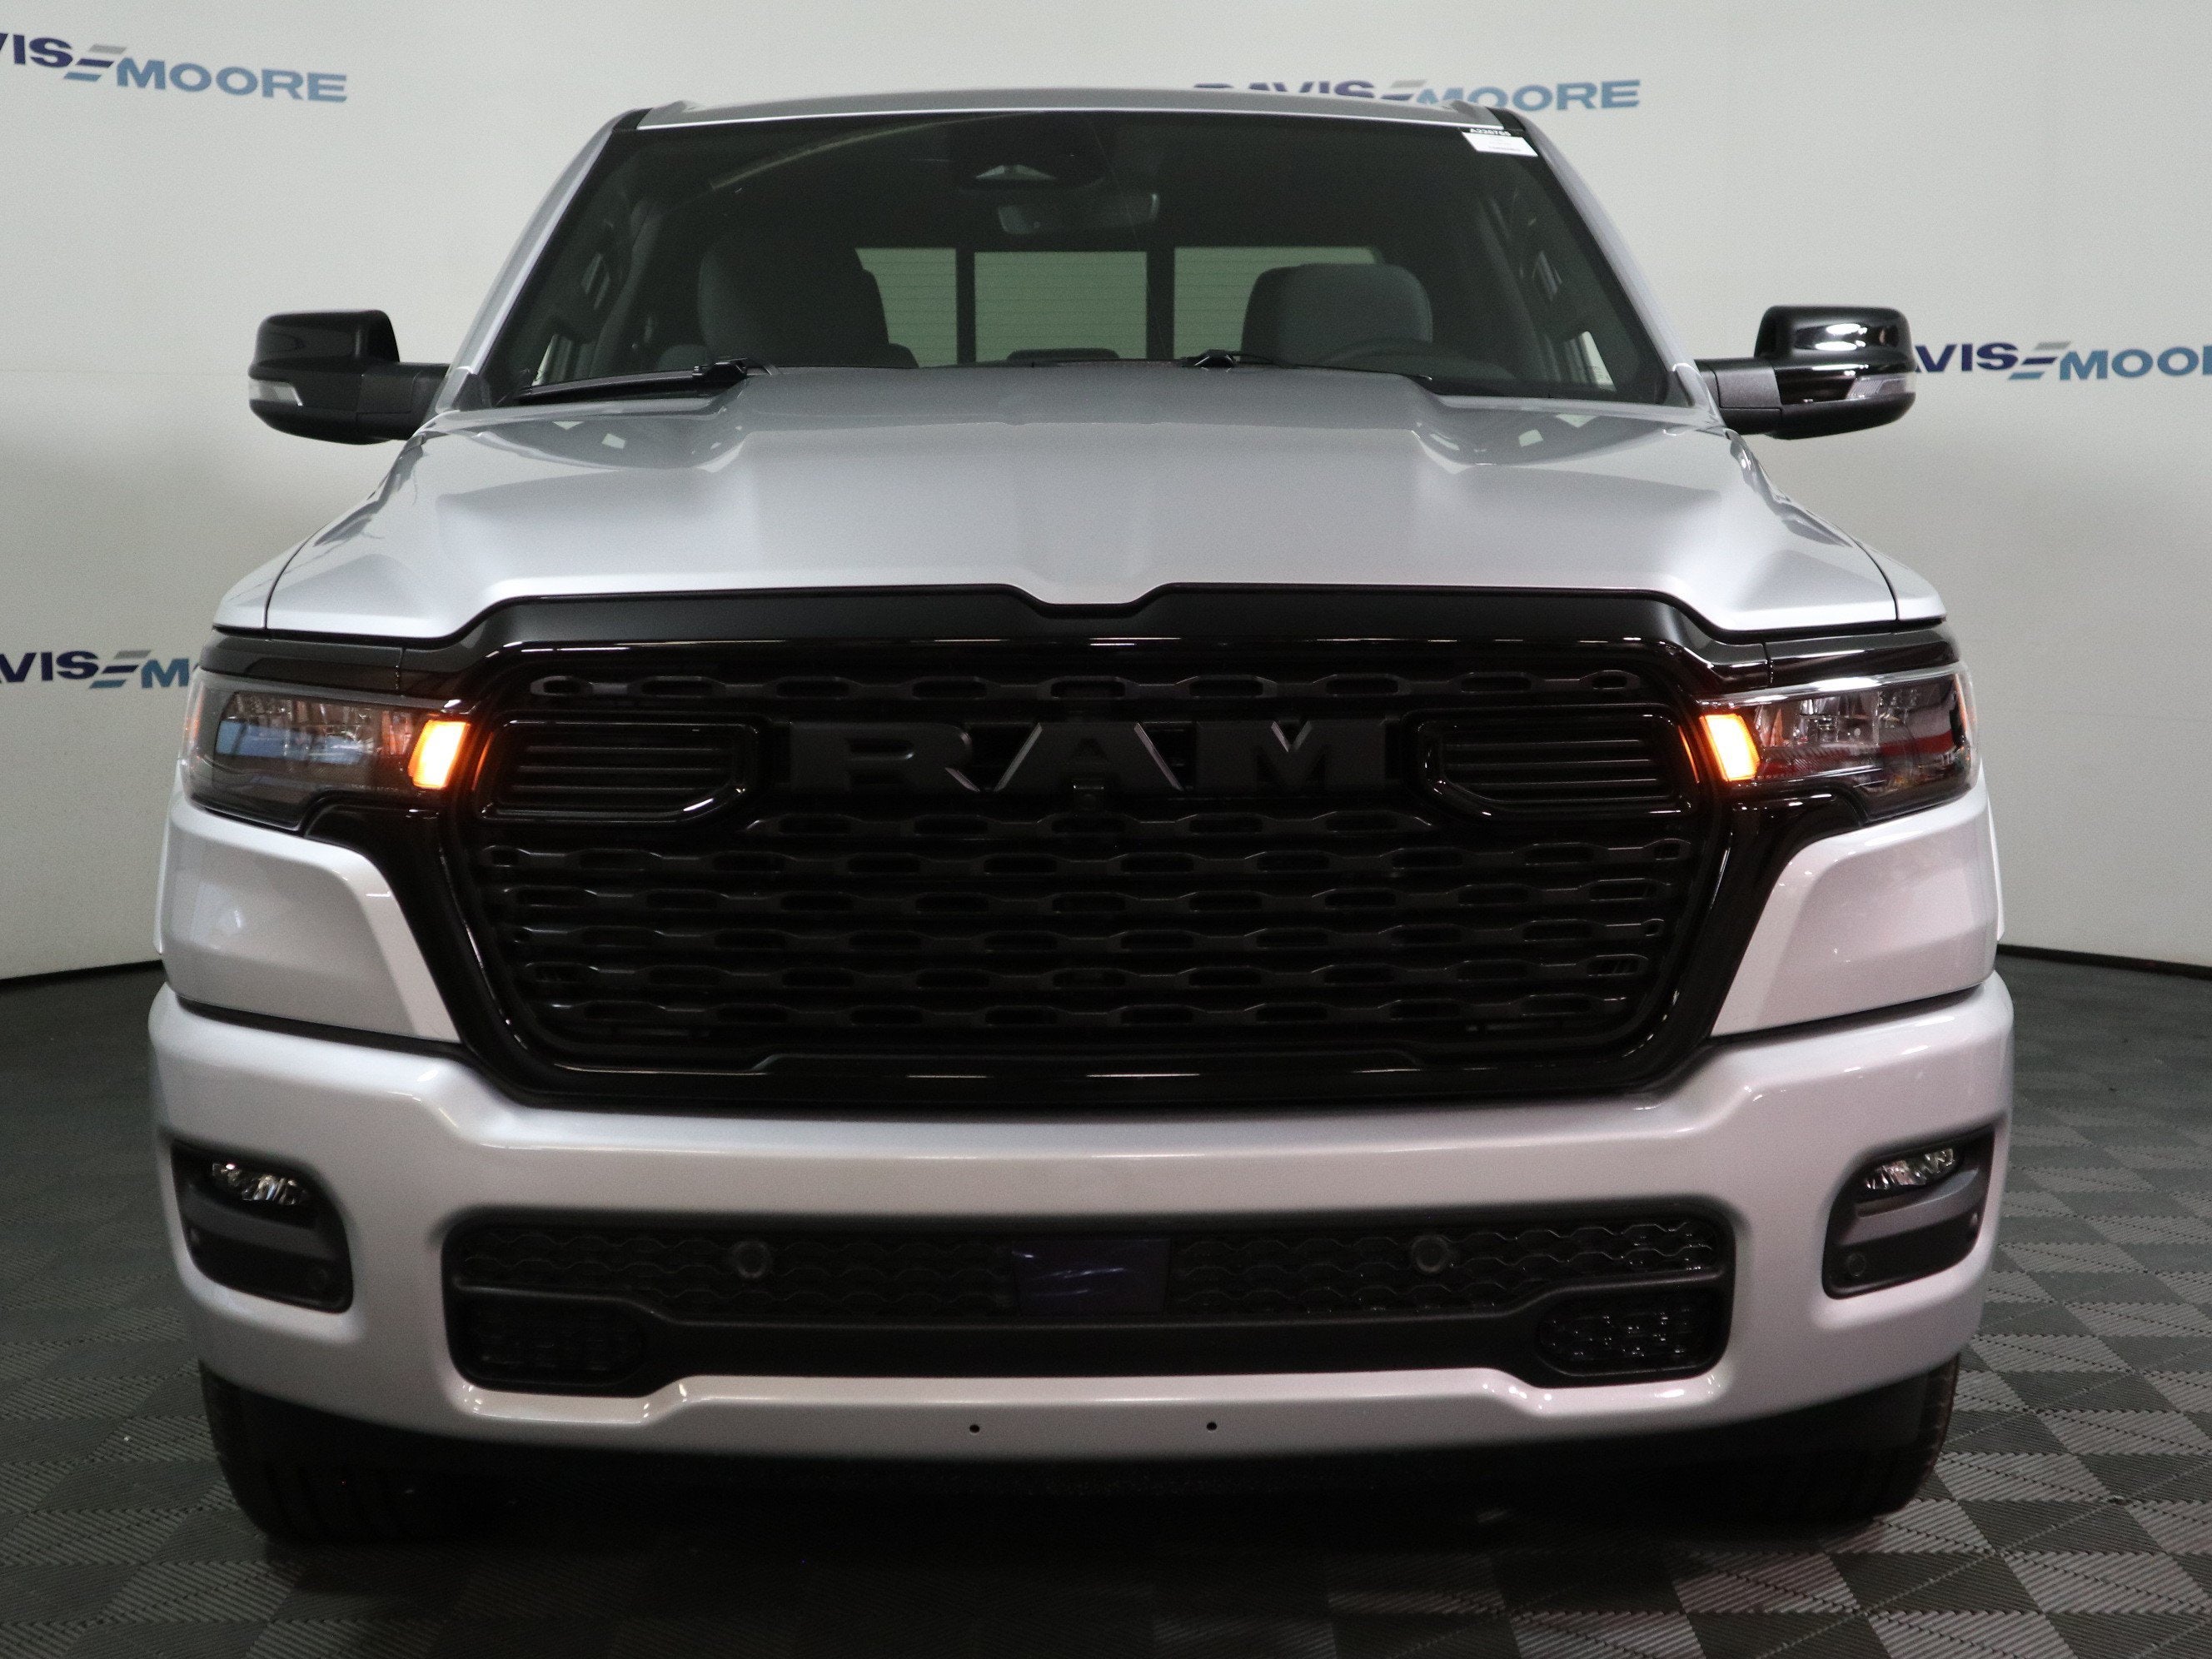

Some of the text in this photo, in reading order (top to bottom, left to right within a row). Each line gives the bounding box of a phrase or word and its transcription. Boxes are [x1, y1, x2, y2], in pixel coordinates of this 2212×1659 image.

[0, 32, 348, 103] IS MOORE
[1416, 79, 1642, 112] MOORE
[1915, 342, 2212, 381] VIS MOO
[0, 650, 99, 682] VIS
[789, 720, 1386, 791] RAM
